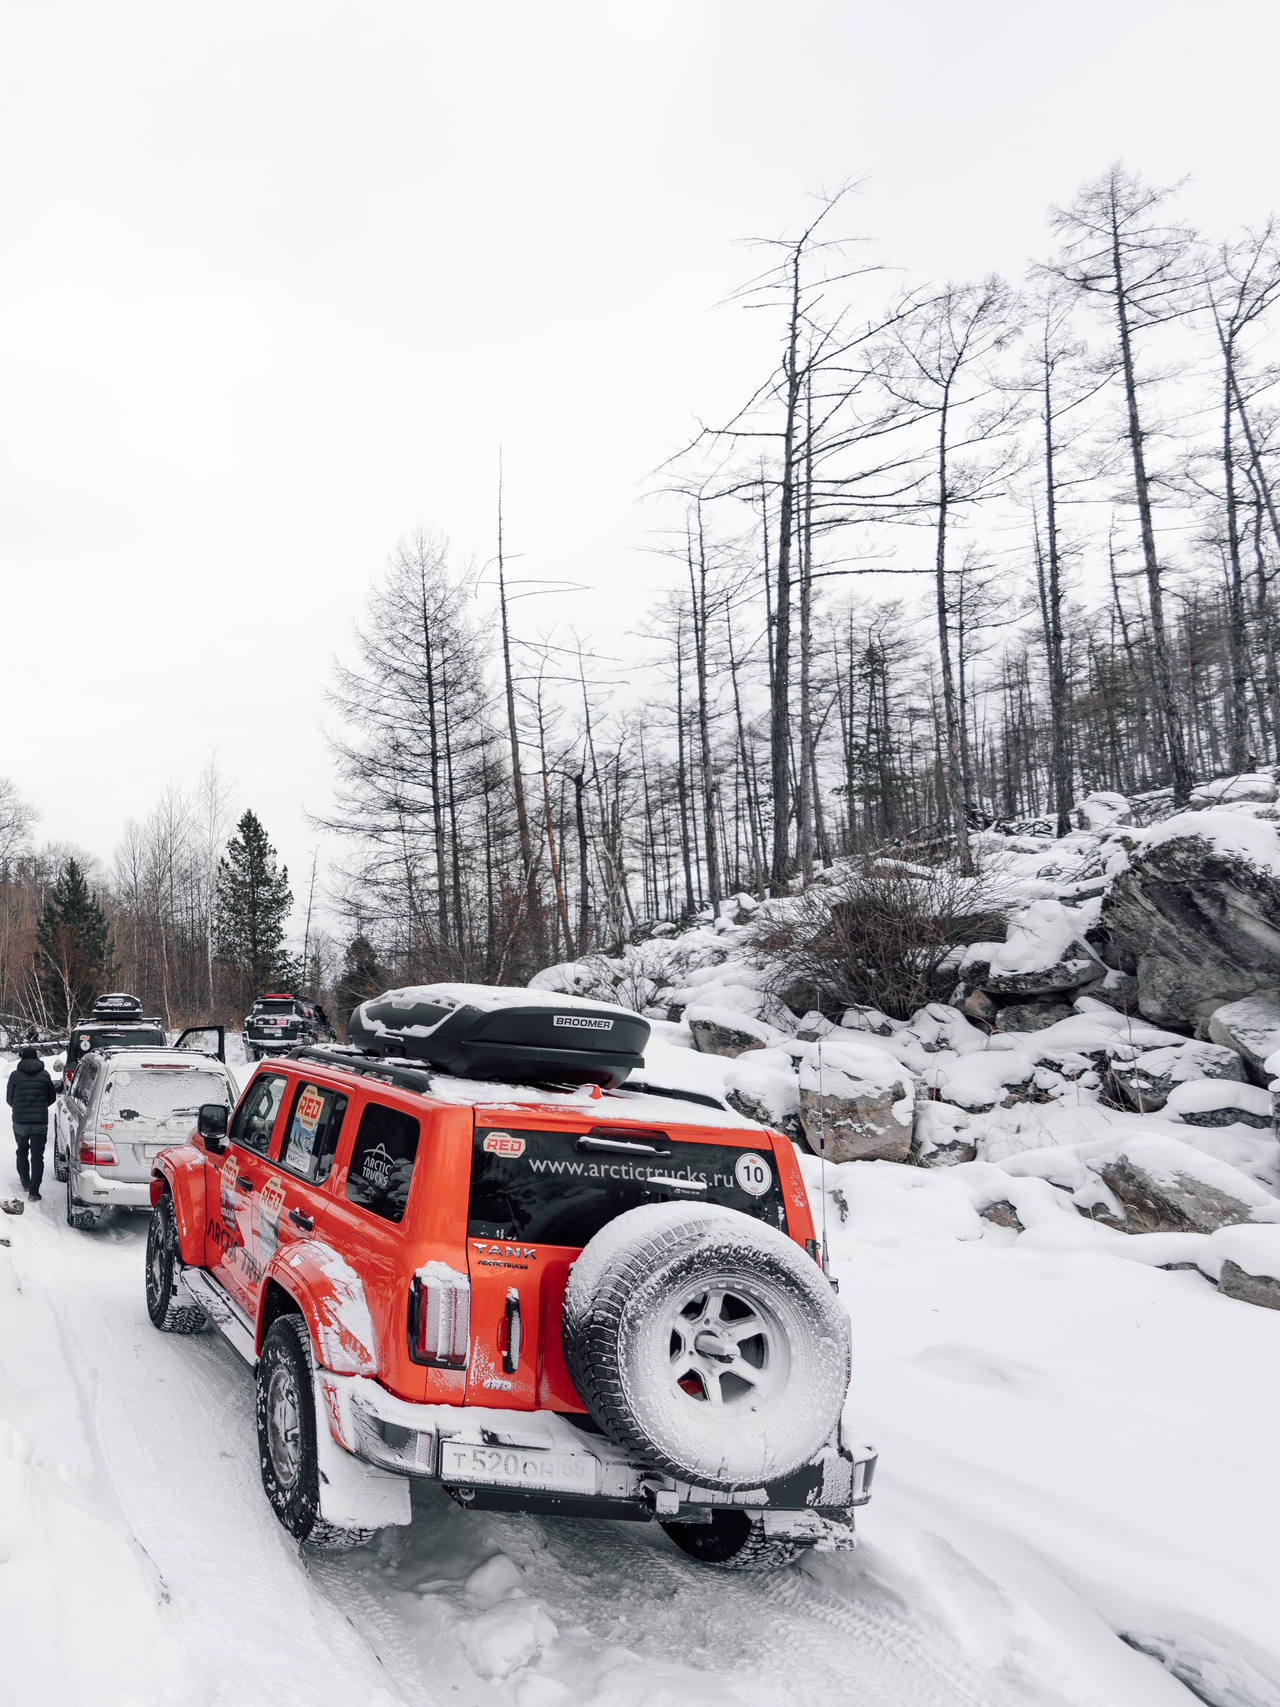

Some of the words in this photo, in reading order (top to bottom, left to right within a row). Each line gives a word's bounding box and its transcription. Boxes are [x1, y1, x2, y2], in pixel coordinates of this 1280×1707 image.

[556, 1017, 611, 1029] BROOMER
[298, 1095, 322, 1119] RED
[486, 1138, 522, 1152] RED
[363, 1156, 391, 1175] ARCTIC
[528, 1158, 734, 1188] www.arctictrucks.ru
[743, 1165, 764, 1184] 10
[362, 1166, 389, 1187] TRUCKS
[260, 1186, 283, 1212] RED
[472, 1242, 536, 1260] TANK
[477, 1260, 502, 1268] ARCTIC
[503, 1262, 528, 1270] TRUCKS
